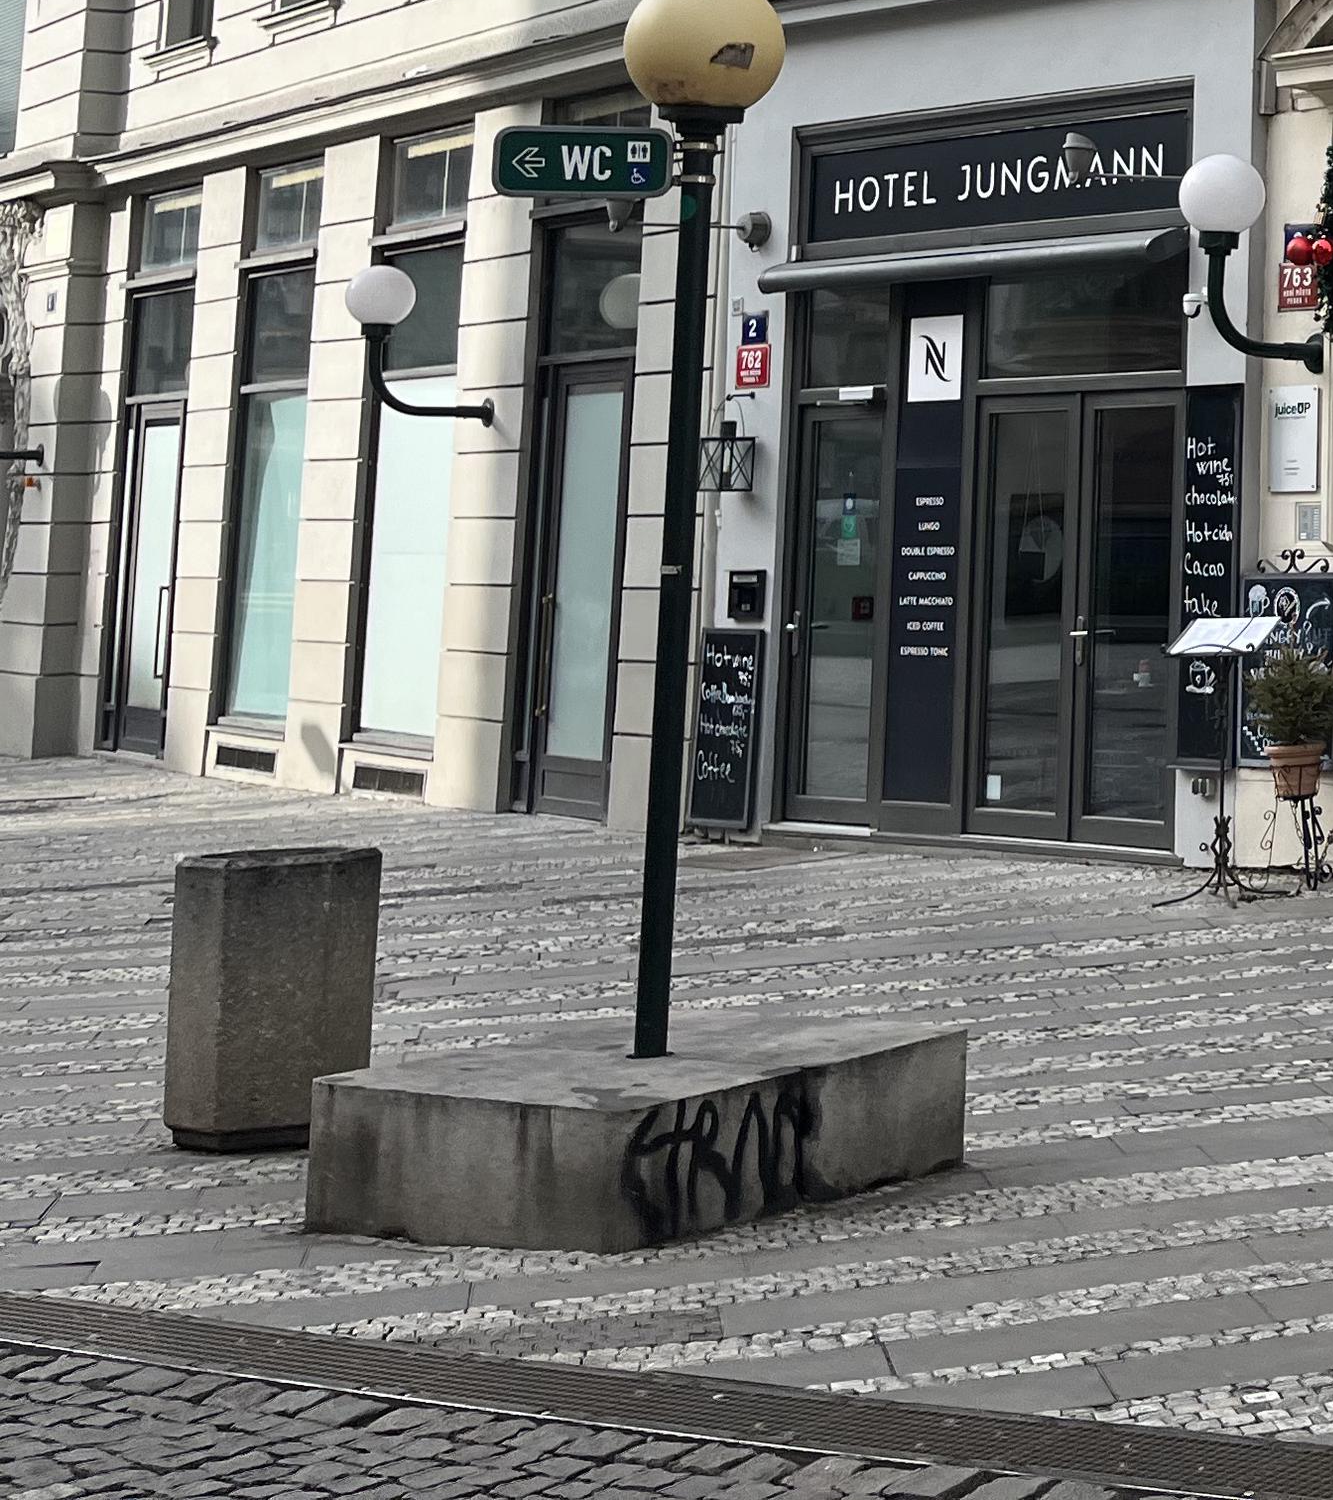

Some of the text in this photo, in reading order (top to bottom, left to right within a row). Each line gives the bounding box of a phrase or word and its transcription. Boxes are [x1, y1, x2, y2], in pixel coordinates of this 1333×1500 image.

[561, 145, 612, 181] WC
[834, 171, 937, 214] HOTEL
[1283, 267, 1313, 288] 763
[748, 319, 757, 338] 2
[741, 350, 762, 370] 762
[1196, 458, 1232, 475] wine
[915, 497, 944, 506] ESPRESSO
[918, 522, 940, 531] LUNGO
[901, 547, 955, 556] DOUBLE ESPRESSO
[1184, 552, 1225, 577] Cacao
[908, 571, 947, 581] CAPPUCCINO
[899, 596, 917, 606] LATTE
[1184, 585, 1221, 617] take
[922, 621, 944, 631] COFFEE
[706, 644, 731, 667] Hot
[900, 647, 929, 656] ESPRESSO
[696, 750, 735, 783] Coffee
